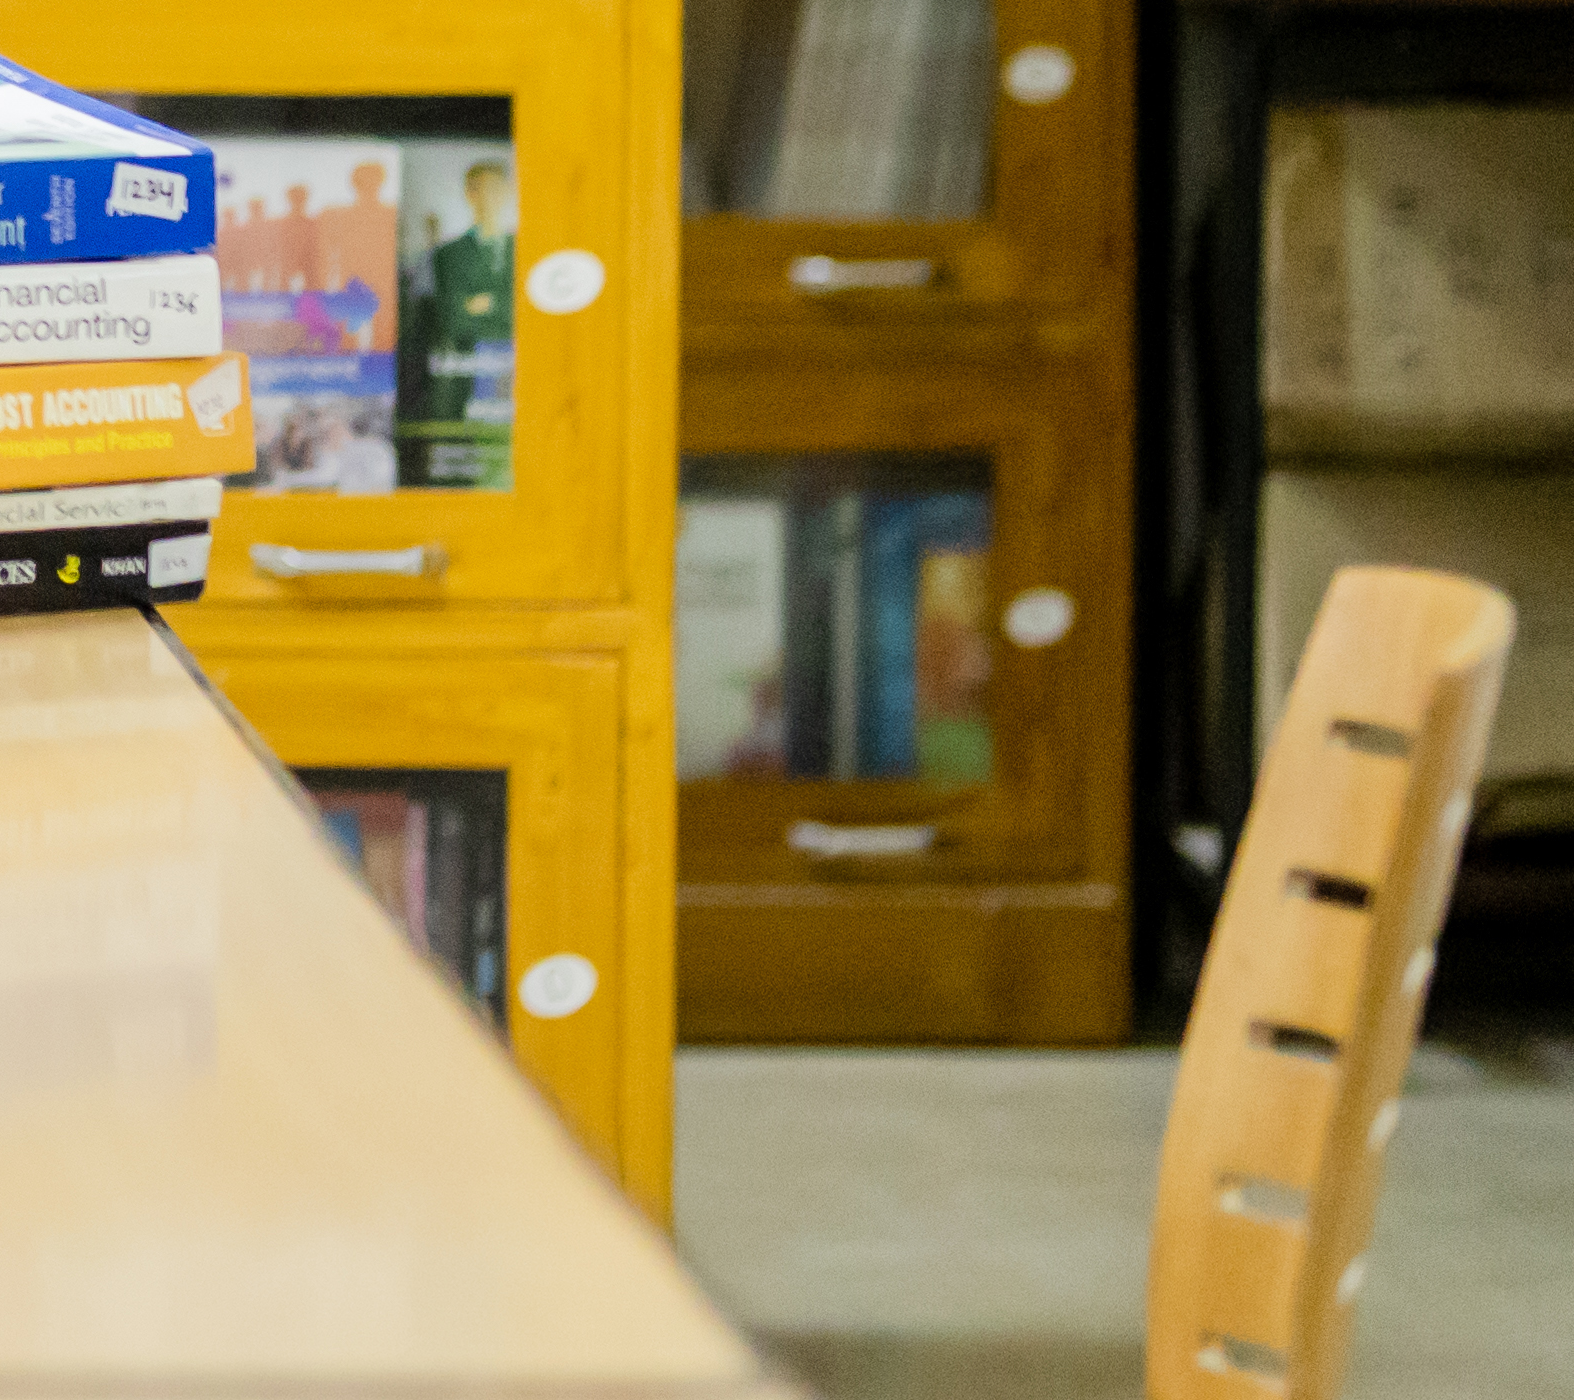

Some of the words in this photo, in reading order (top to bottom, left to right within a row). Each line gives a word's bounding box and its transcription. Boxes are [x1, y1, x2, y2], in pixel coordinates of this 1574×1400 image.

[43, 383, 183, 427] ACCOUNTING
[53, 499, 126, 523] Servic
[101, 557, 146, 577] KHAN
